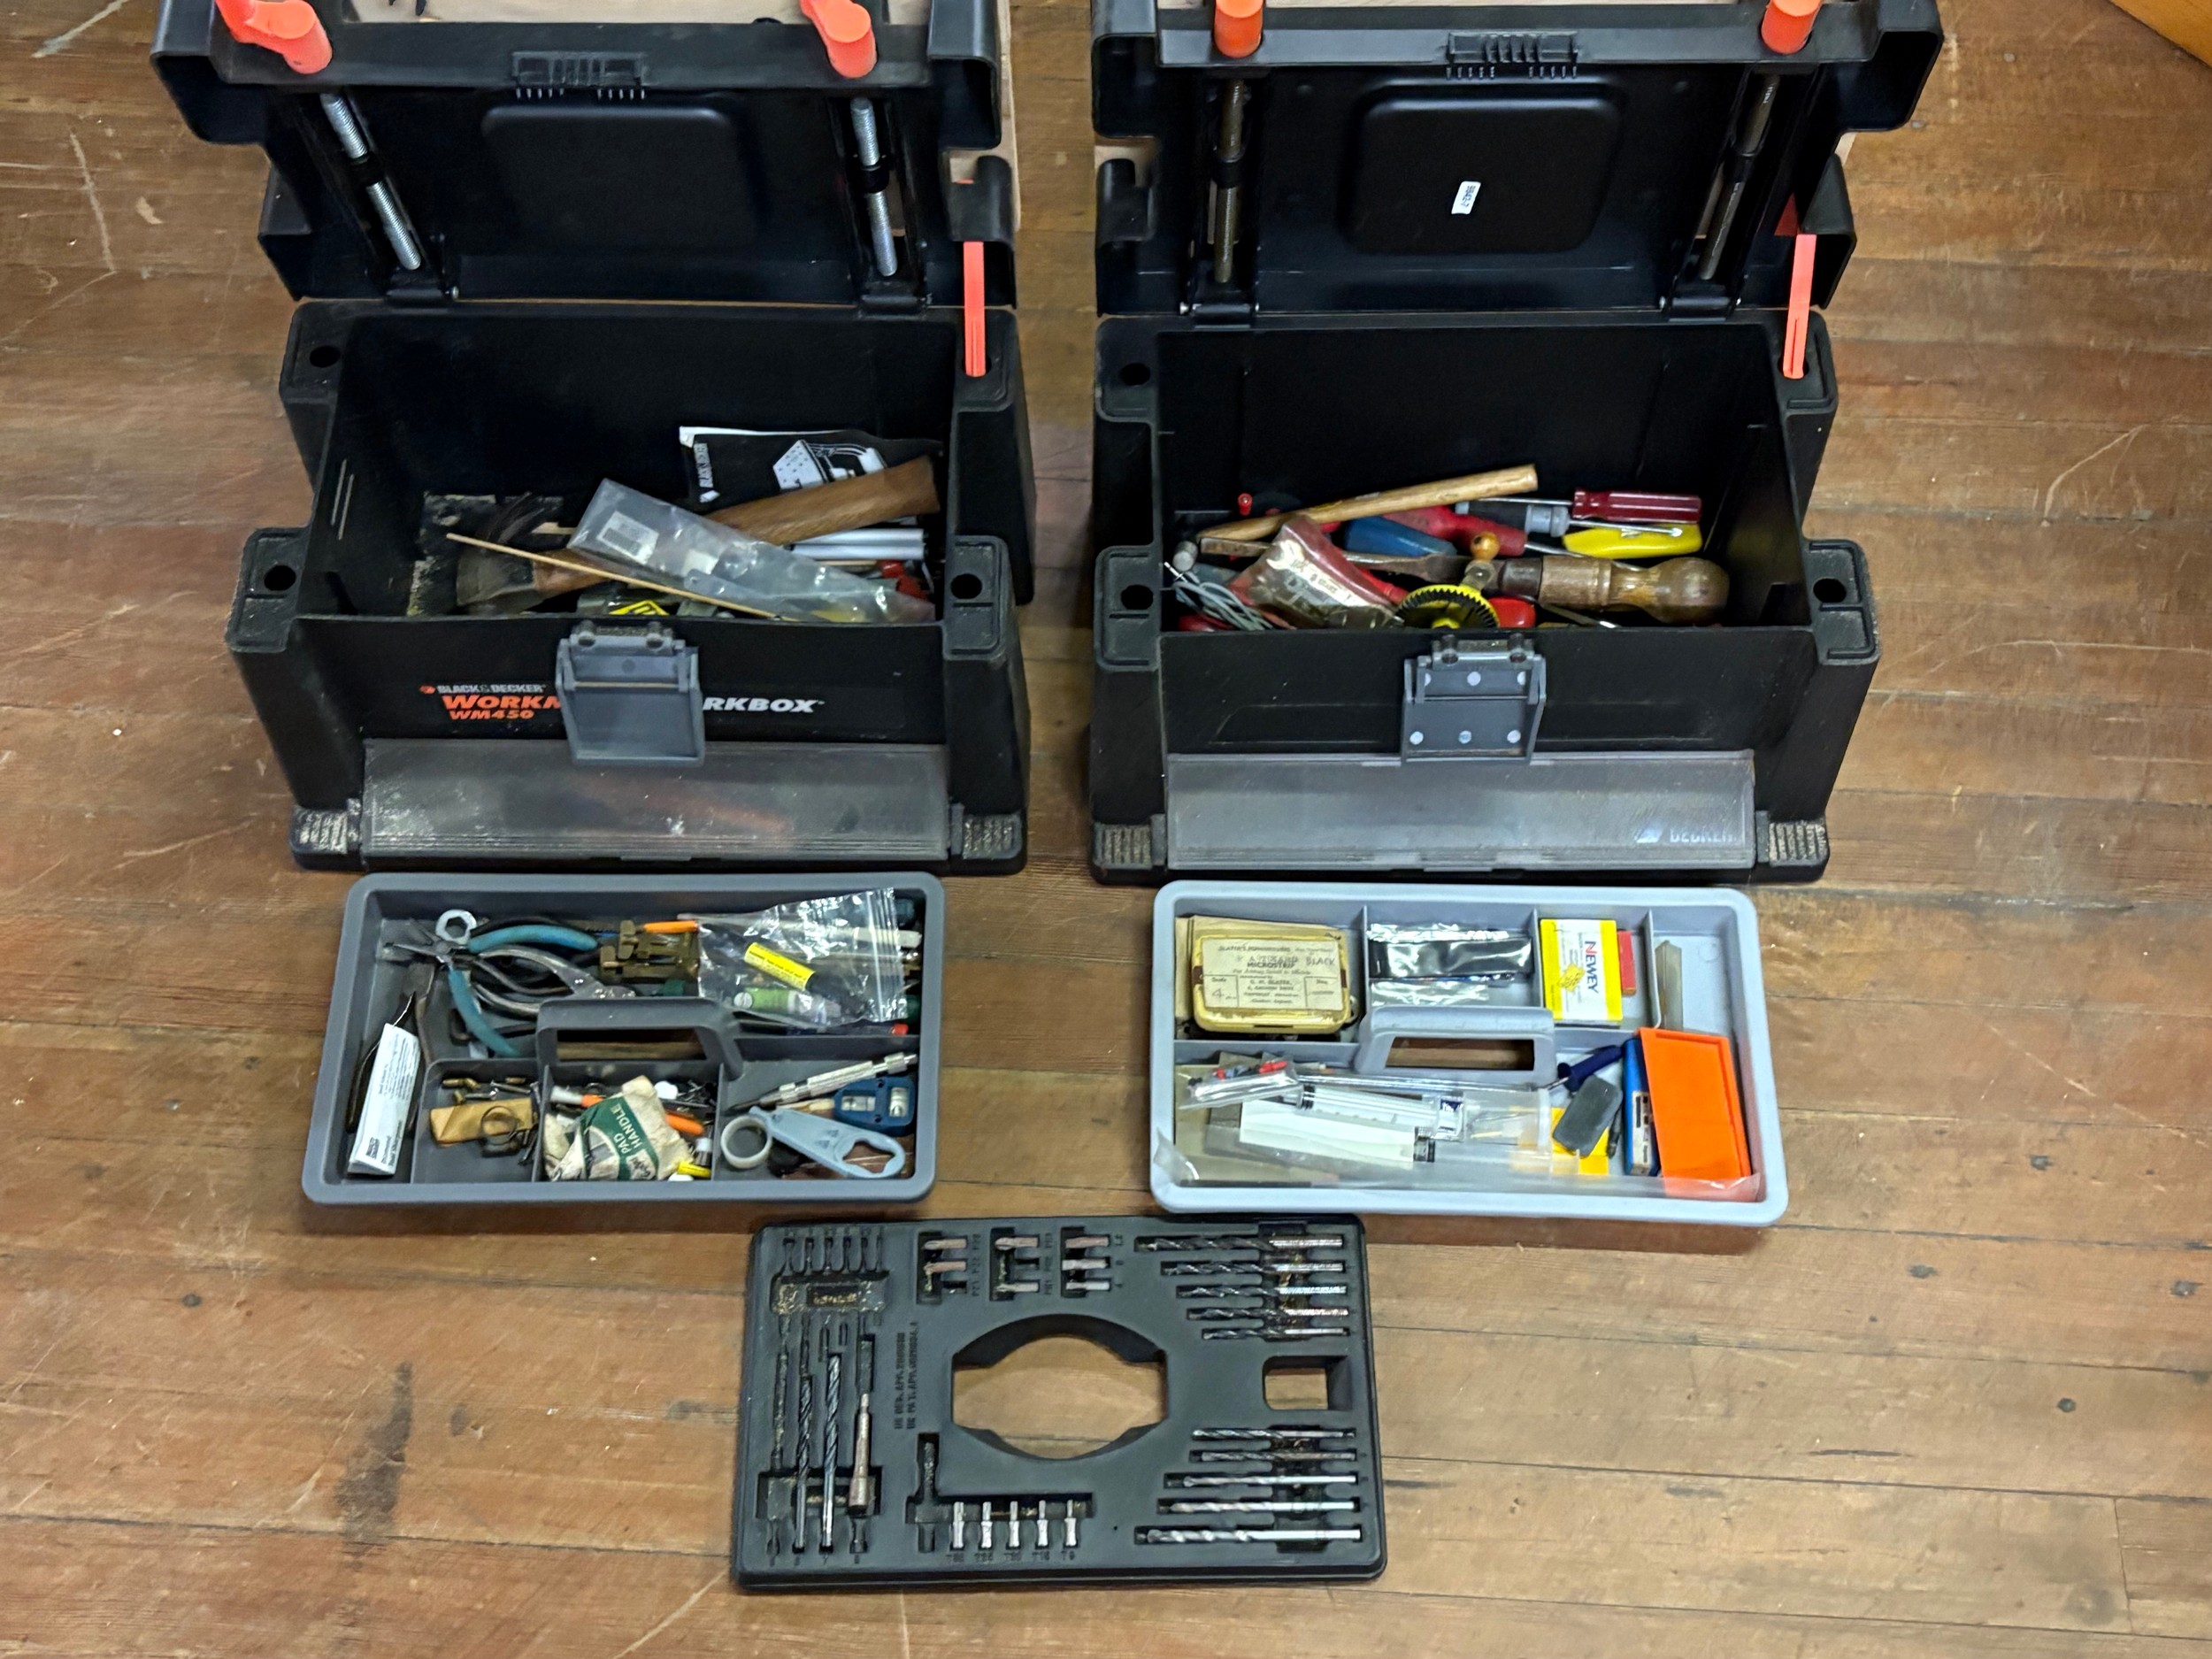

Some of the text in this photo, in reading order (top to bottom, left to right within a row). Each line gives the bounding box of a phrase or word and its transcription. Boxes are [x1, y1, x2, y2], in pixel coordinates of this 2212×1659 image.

[449, 710, 535, 720] WM450
[703, 696, 818, 713] RKBOX
[1585, 941, 1599, 994] NEWEY
[611, 1104, 642, 1148] HANDLE
[613, 1133, 633, 1154] PAD
